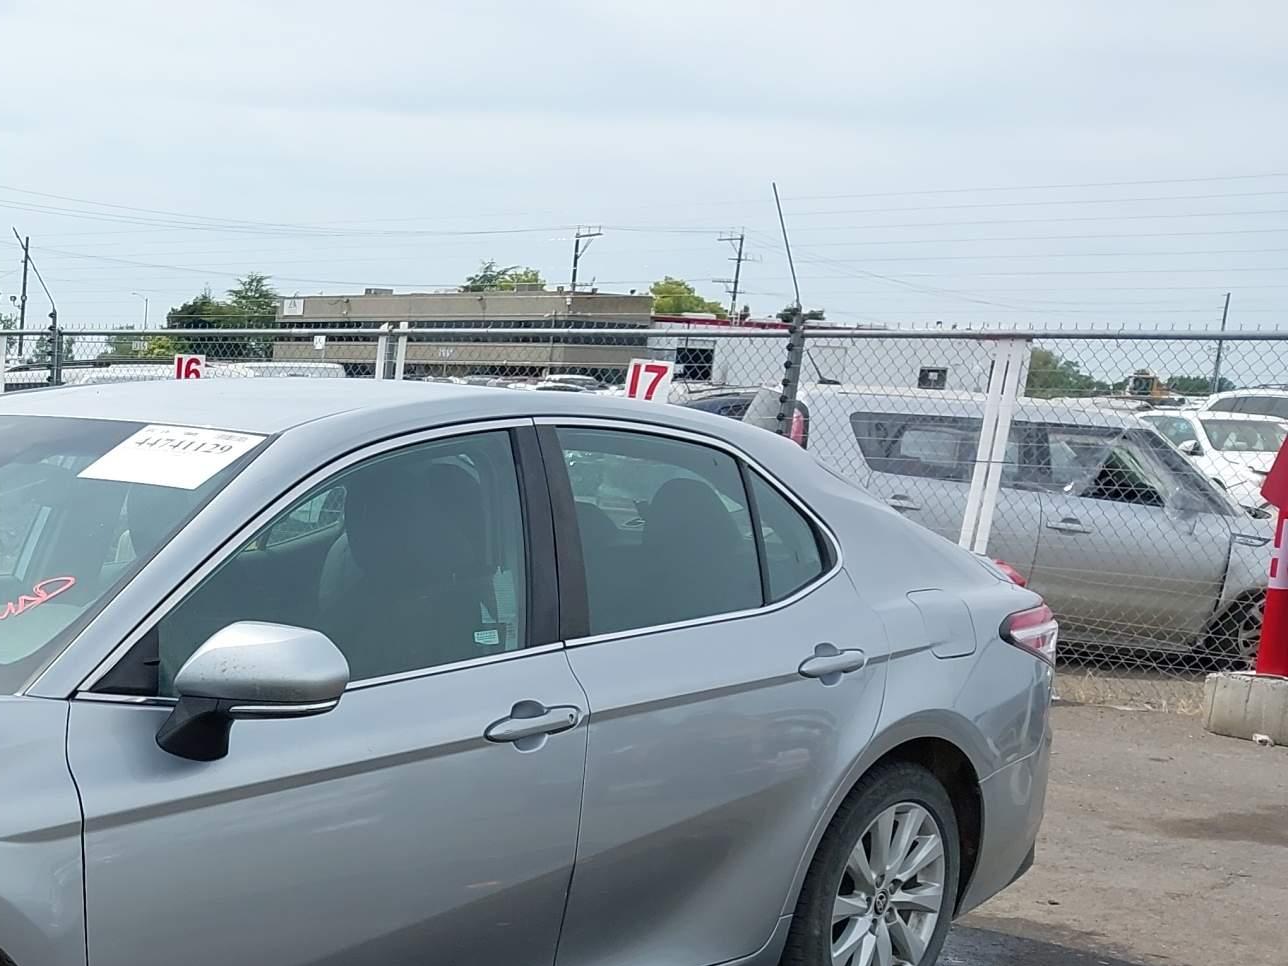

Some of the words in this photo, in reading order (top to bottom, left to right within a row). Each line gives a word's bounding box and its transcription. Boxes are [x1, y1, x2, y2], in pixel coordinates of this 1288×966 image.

[176, 357, 201, 380] 16
[628, 363, 668, 401] 17
[135, 436, 233, 454] 44741129
